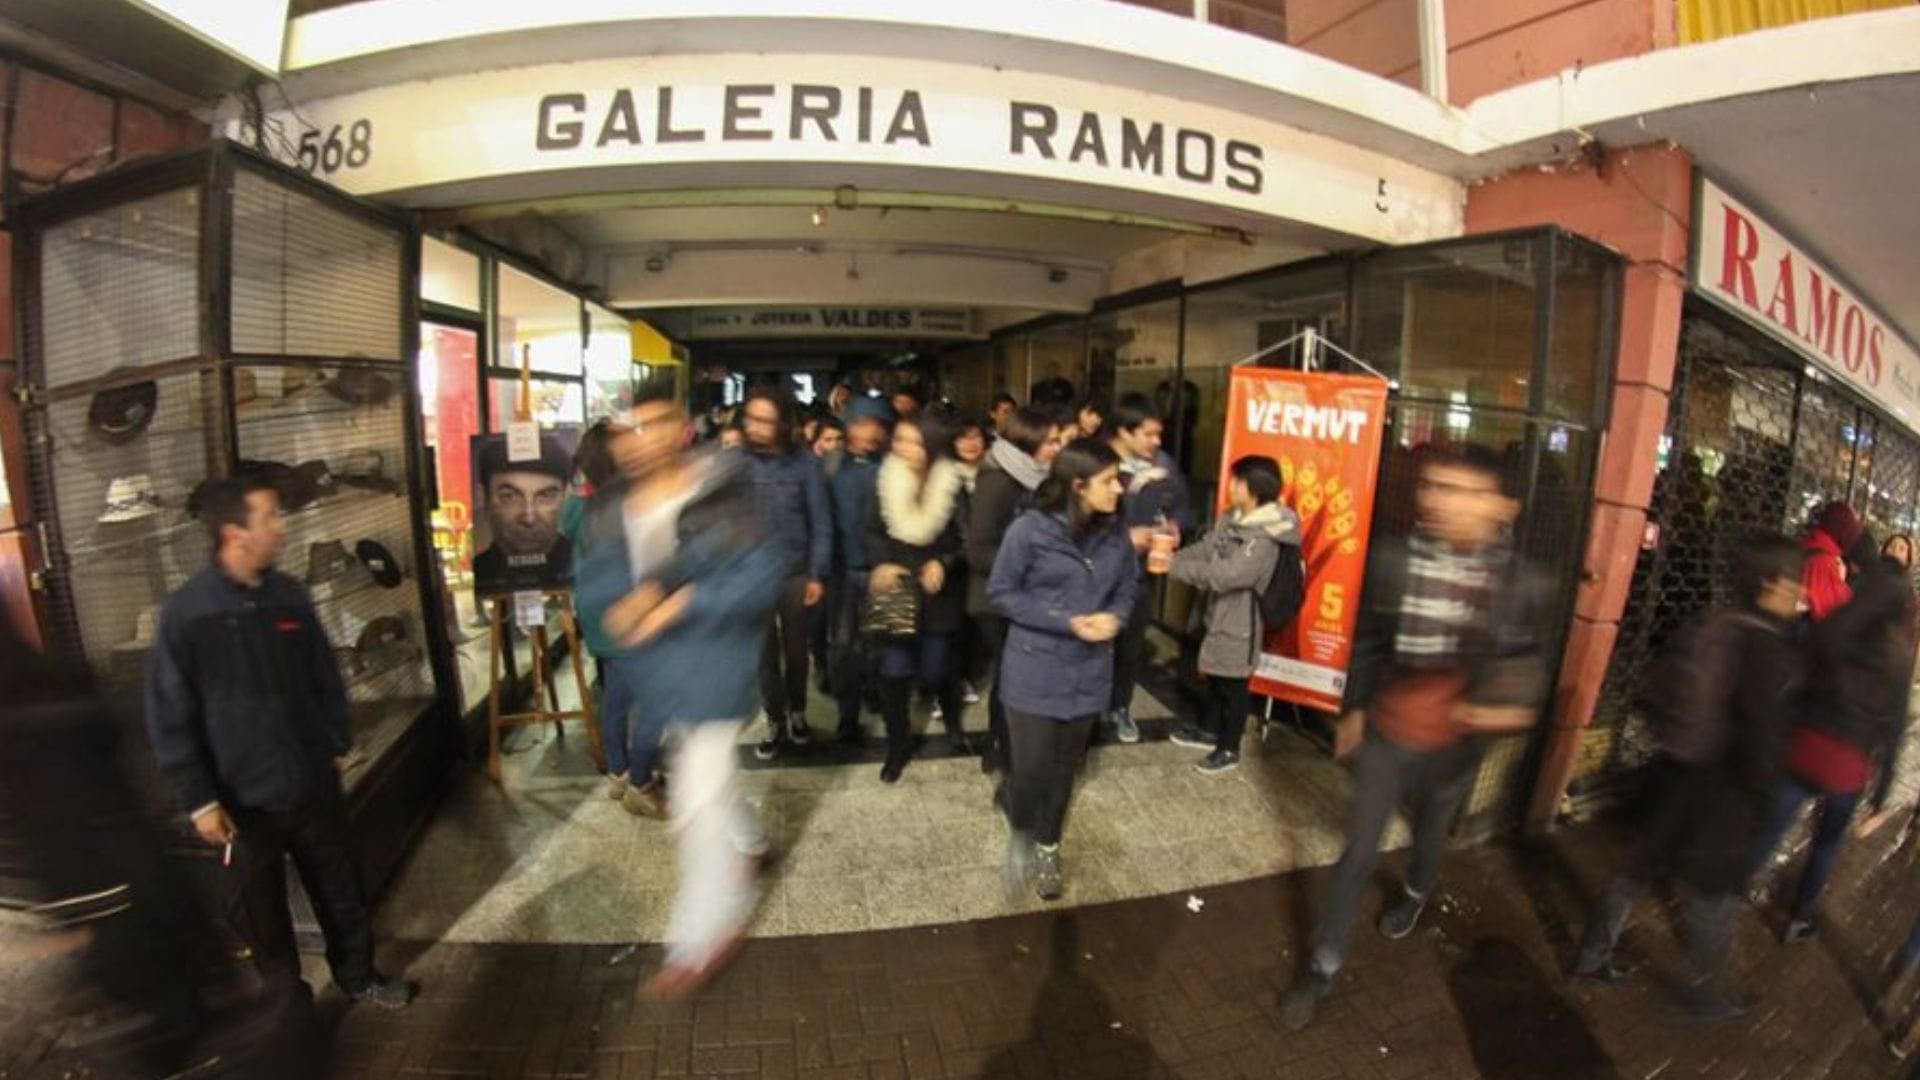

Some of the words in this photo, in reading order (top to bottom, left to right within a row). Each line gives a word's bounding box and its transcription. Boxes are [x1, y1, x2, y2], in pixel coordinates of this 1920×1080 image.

[299, 118, 372, 174] 568
[536, 83, 931, 151] GALERIA
[1009, 100, 1264, 195] RAMOS
[820, 308, 913, 328] VALDES
[1717, 202, 1885, 388] RAMOS
[1319, 582, 1344, 620] 5
